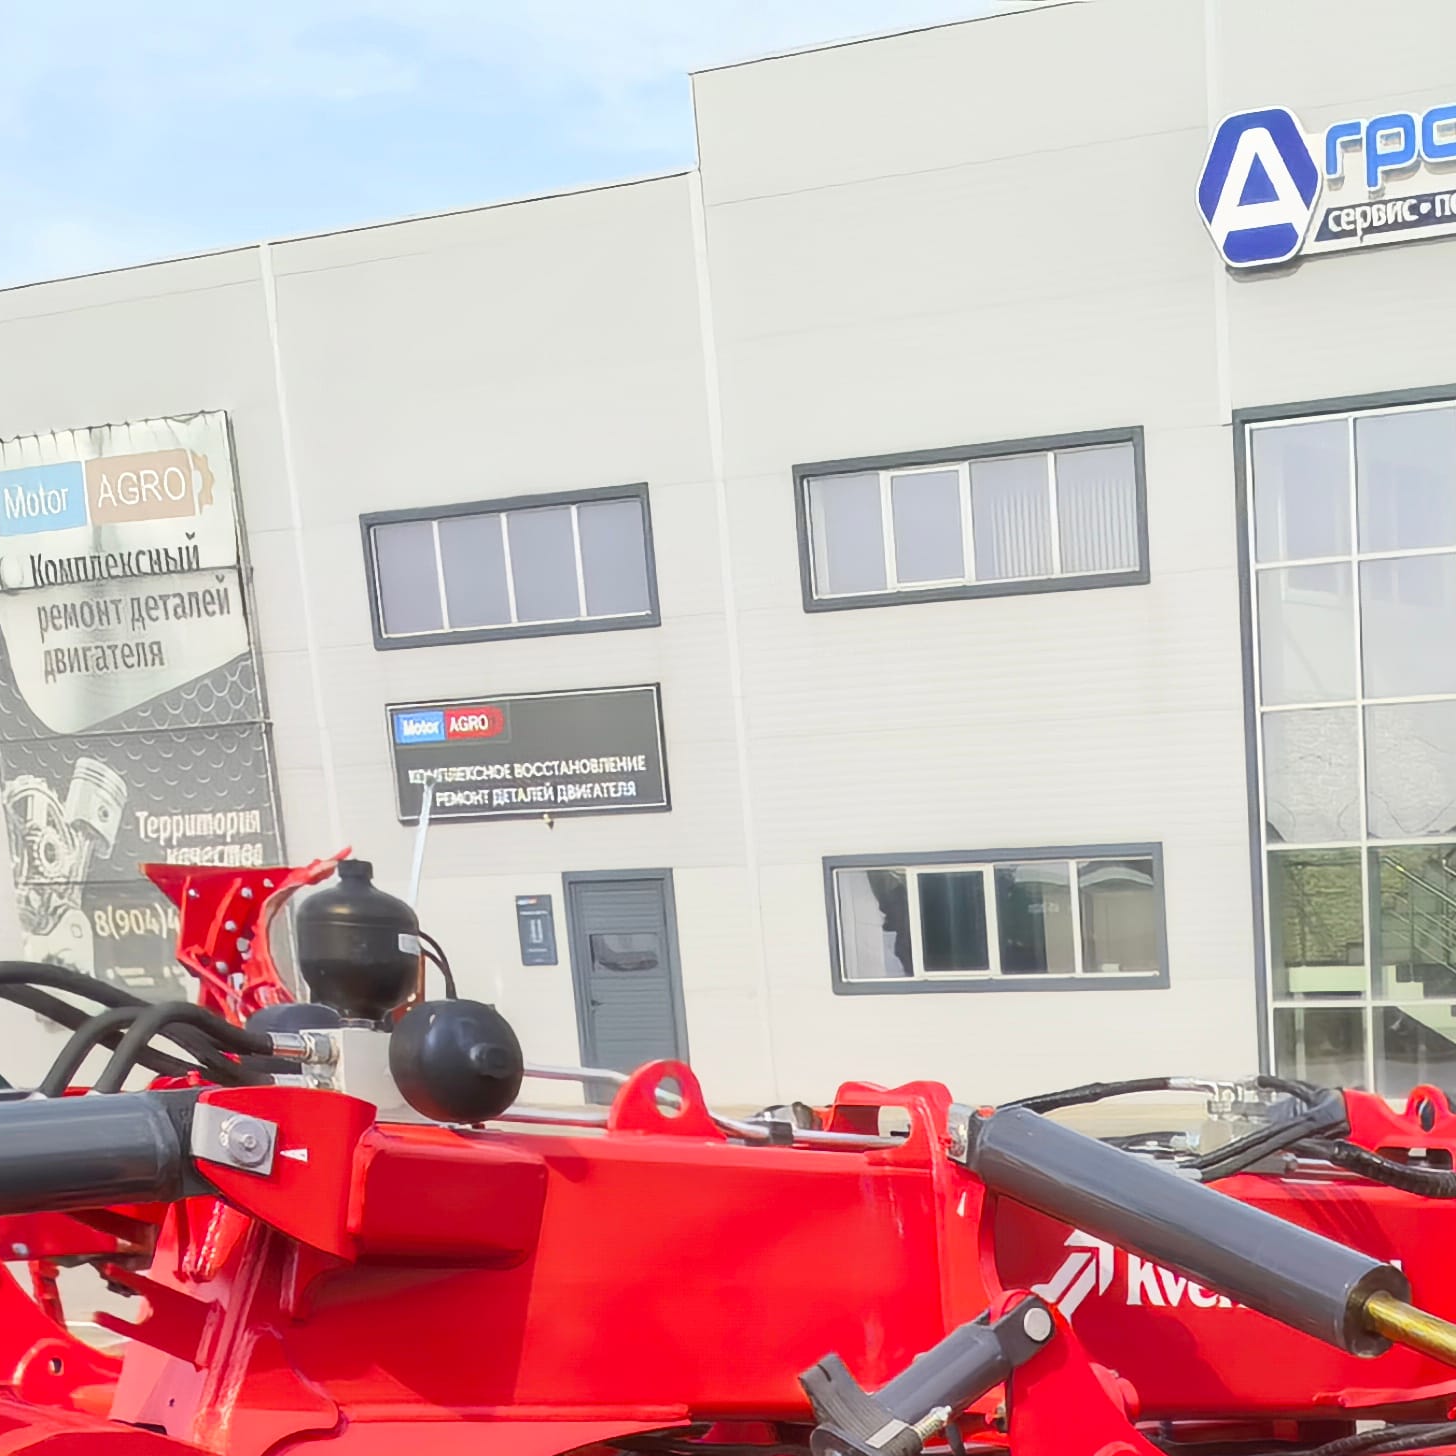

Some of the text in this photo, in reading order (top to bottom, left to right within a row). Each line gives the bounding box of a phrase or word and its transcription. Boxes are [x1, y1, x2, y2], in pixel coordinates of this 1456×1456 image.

[3, 466, 187, 520] Motor AGRO
[29, 531, 201, 589] Комплексный
[37, 573, 232, 644] ремонт деталей
[43, 640, 167, 685] двигателя
[403, 713, 490, 737] Motor AGRO
[514, 754, 647, 779] ВОССТАНОВЛЕНИЕ
[492, 781, 555, 807] ДЕТАЛЕЙ
[556, 780, 637, 803] ДВИГАТЕЛЯ
